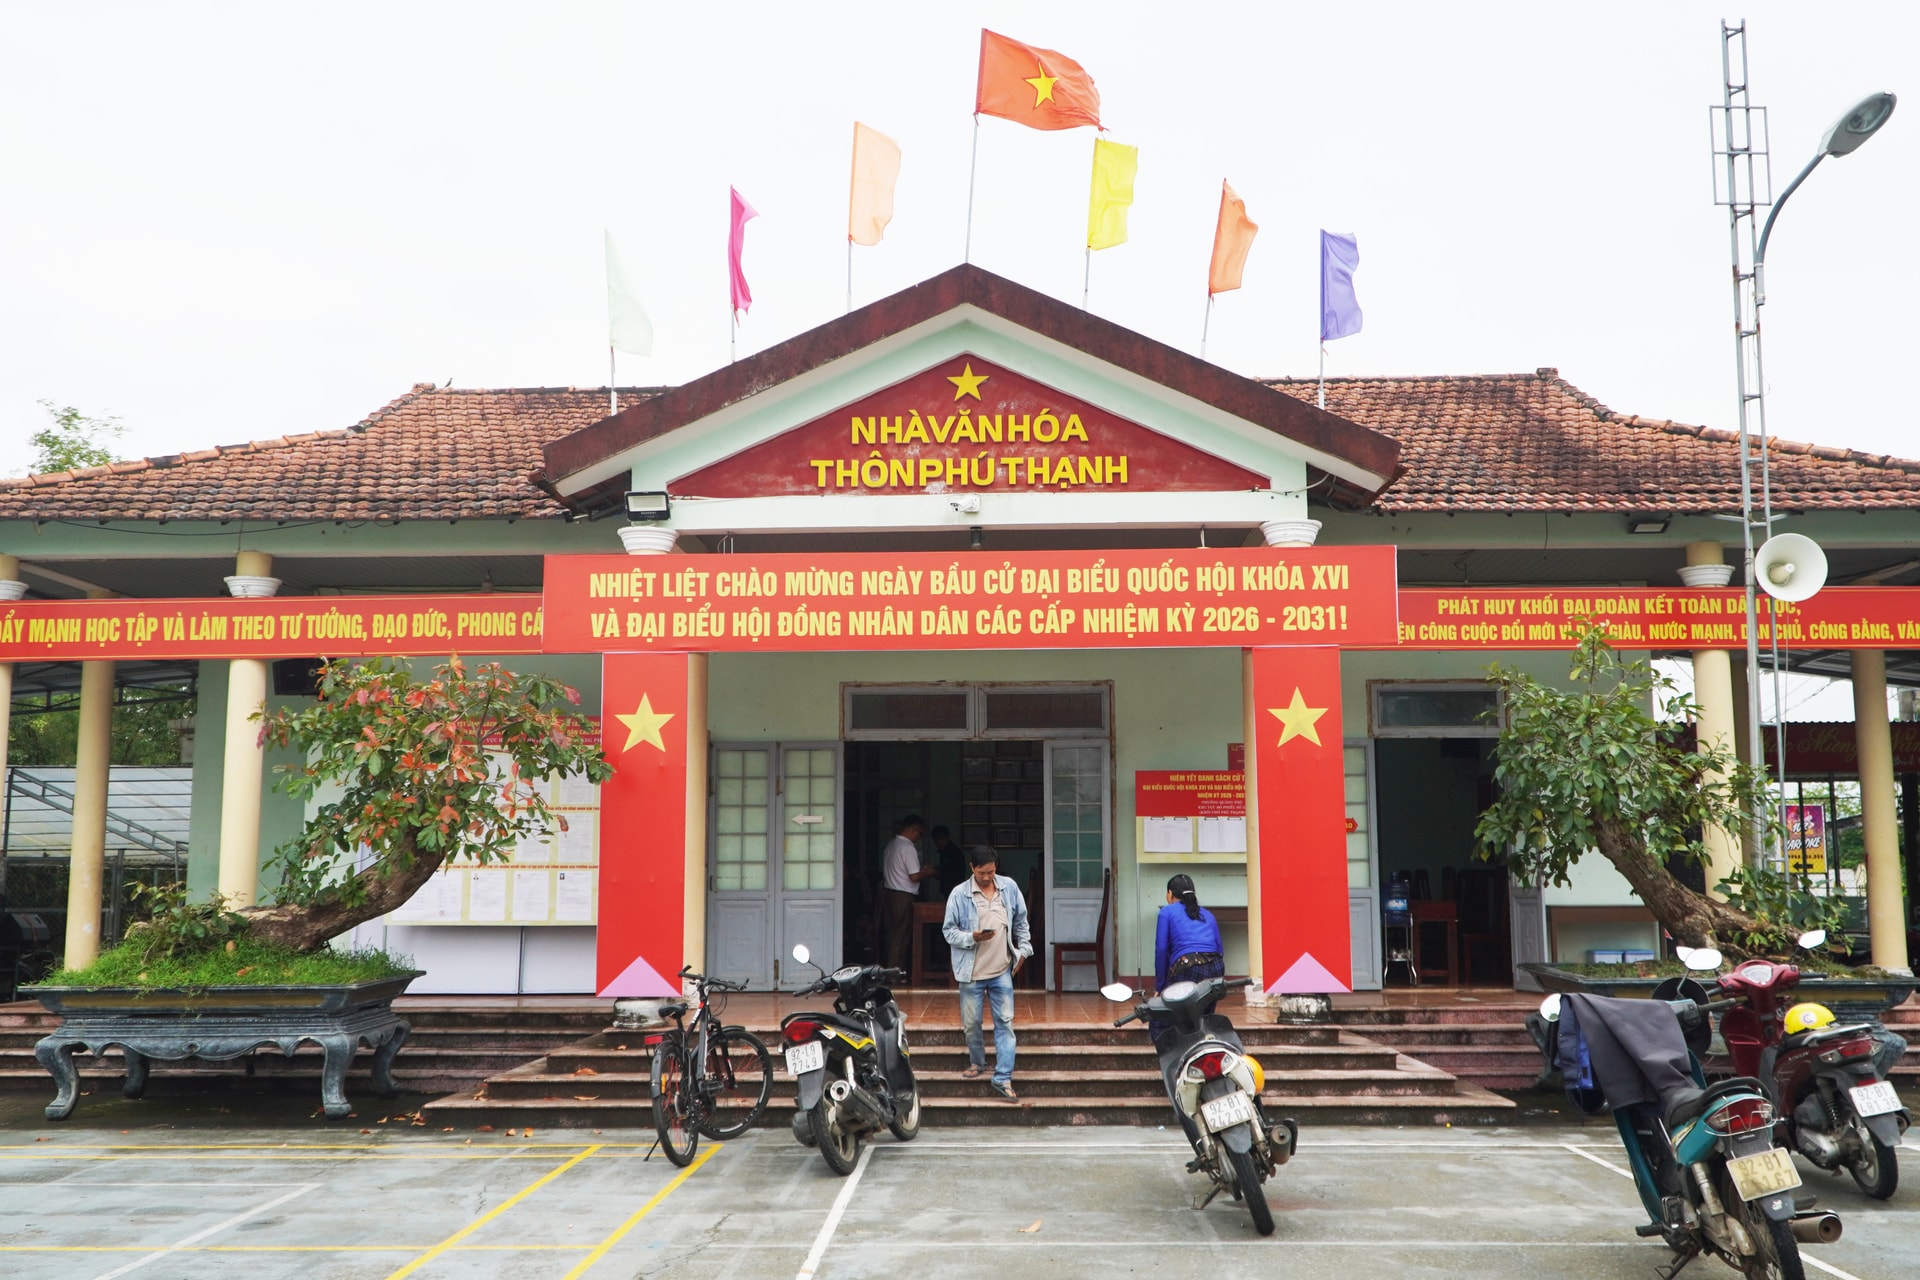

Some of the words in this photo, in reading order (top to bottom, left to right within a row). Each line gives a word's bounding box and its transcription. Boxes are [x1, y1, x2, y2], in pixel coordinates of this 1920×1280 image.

[852, 409, 930, 444] NHÀ
[927, 408, 1003, 443] VĂN
[1008, 408, 1089, 442] HÓA
[810, 450, 914, 487] THÔN
[919, 451, 995, 486] PHÚ
[1000, 455, 1128, 489] THẠNH
[589, 567, 656, 602] NHIỆT
[663, 567, 709, 602] LIỆT
[716, 566, 777, 597] CHÀO
[785, 566, 854, 596] MỪNG
[861, 565, 923, 596] NGÀY
[930, 561, 976, 595] BẦU
[983, 561, 1017, 595] CỬ
[1021, 569, 1060, 599] ĐẠI
[1067, 558, 1119, 593] BIỂU
[1127, 558, 1189, 595] QUỐC
[1196, 561, 1235, 597] HỘI
[1242, 560, 1305, 591] KHÓA
[1312, 564, 1349, 590] XVI
[590, 608, 620, 638] VÀ
[626, 612, 665, 643] ĐẠI
[673, 602, 725, 638] BIỂU
[733, 606, 770, 642] HỘI
[777, 603, 841, 637] ĐỒNG
[848, 606, 913, 636] NHÂN
[921, 605, 968, 635] DÂN
[975, 604, 1022, 635] CÁC
[1029, 600, 1076, 634] CẤP
[1083, 602, 1159, 639] NHIỆM
[1166, 602, 1196, 633] KỲ
[1203, 606, 1259, 632] 2026
[1283, 605, 1347, 631] 2031!
[1438, 596, 1479, 615] PHÁT
[1484, 599, 1515, 615] HUY
[1520, 593, 1558, 615] KHỐI
[1595, 595, 1640, 615] ĐOÀN
[1645, 593, 1674, 614] KẾT
[1679, 595, 1721, 614] TOÀN
[28, 618, 81, 648] MẠNH
[85, 617, 120, 648] HỌC
[125, 612, 158, 647] TẬP
[163, 612, 185, 641] VÀ
[189, 611, 227, 641] LÀM
[232, 615, 275, 640] THEO
[280, 613, 303, 640] TƯ
[306, 606, 367, 641] TƯỞNG,
[372, 613, 408, 644] ĐẠO
[412, 608, 452, 640] ĐỨC,
[457, 611, 516, 637] PHONG
[1419, 621, 1457, 641] CÔNG
[1461, 621, 1498, 644] CUỘC
[1501, 618, 1525, 640] ĐỔI
[1529, 621, 1555, 640] MỚI
[1608, 621, 1645, 642] GIÀU,
[1649, 620, 1687, 640] NƯỚC
[1691, 623, 1737, 643] MẠNH,
[1775, 618, 1806, 642] CHỦ,
[1809, 620, 1848, 640] CÔNG
[1852, 617, 1894, 641] BẰNG,
